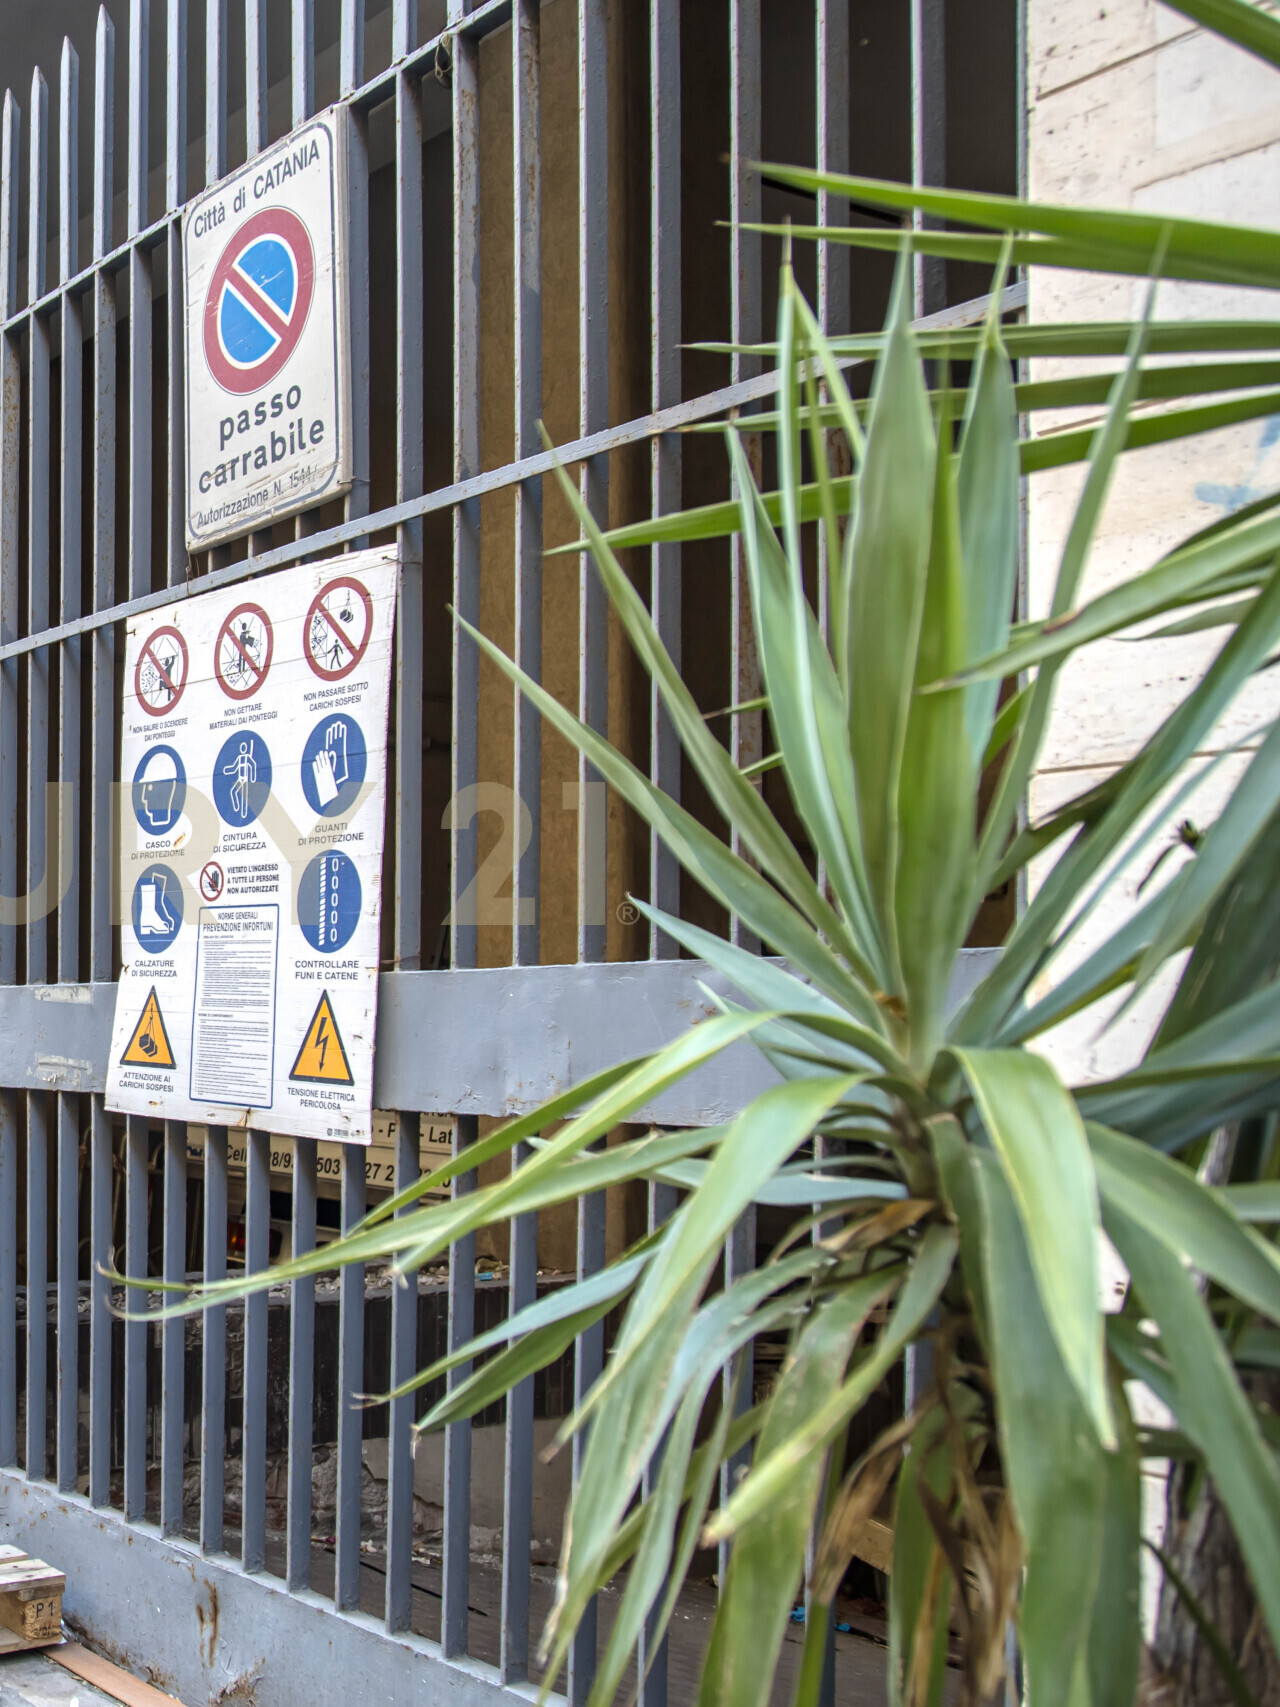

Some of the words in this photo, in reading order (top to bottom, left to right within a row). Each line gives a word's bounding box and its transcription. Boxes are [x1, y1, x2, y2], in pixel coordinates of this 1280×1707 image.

[194, 202, 226, 238] Città
[233, 186, 246, 213] di
[253, 139, 320, 199] CATANIA
[220, 385, 301, 451] passo
[198, 417, 324, 494] carrabile
[196, 488, 269, 529] Autorizzazione
[304, 692, 317, 701] NON
[318, 685, 346, 700] PASSARE
[347, 681, 369, 693] SOTTO
[309, 700, 334, 711] CARICHI
[335, 694, 362, 707] SOSPESI
[224, 709, 236, 717] NON
[237, 703, 262, 714] GETTARE
[132, 725, 143, 734] NON
[143, 722, 159, 733] SALIRE
[164, 717, 189, 729] SCENDERE
[209, 718, 238, 730] MATERIALI
[238, 716, 248, 725] DAI
[248, 711, 278, 724] PONTEGGI
[152, 730, 176, 740] PONTEGGI
[315, 822, 348, 833] GUANTI
[223, 832, 258, 842] CINTURA
[298, 837, 307, 846] DI
[308, 832, 365, 845] PROTEZIONE
[145, 840, 171, 849] CASCO
[213, 845, 221, 853] DI
[222, 842, 267, 853] SICUREZZA
[131, 852, 139, 860] DI
[139, 849, 185, 859] PROTEZIONE
[227, 866, 248, 874] VIETATO
[248, 863, 279, 872] L'INGRESSO
[232, 876, 248, 884] TUTTE
[256, 874, 280, 882] PERSONE
[240, 885, 279, 894] AUTORIZZATE
[218, 912, 235, 920] NORME
[235, 911, 259, 920] GENERALI
[202, 922, 241, 932] PREVENZIONE
[242, 921, 274, 931] INFORTUNI
[135, 959, 175, 968] CALZATURE
[295, 960, 360, 969] CONTROLLARE
[131, 969, 139, 977] DI
[139, 969, 178, 978] SICUREZZA
[295, 971, 315, 980] FUNI
[317, 972, 322, 980] E
[324, 972, 358, 981] CATENE
[123, 1071, 163, 1083] ATTENZIONE
[163, 1075, 171, 1083] AI
[119, 1080, 145, 1090] CARICHI
[145, 1082, 175, 1093] SOSPESI
[287, 1087, 319, 1098] TENSIONE
[320, 1091, 356, 1103] ELETTRICA
[299, 1099, 341, 1111] PERICOLOSA
